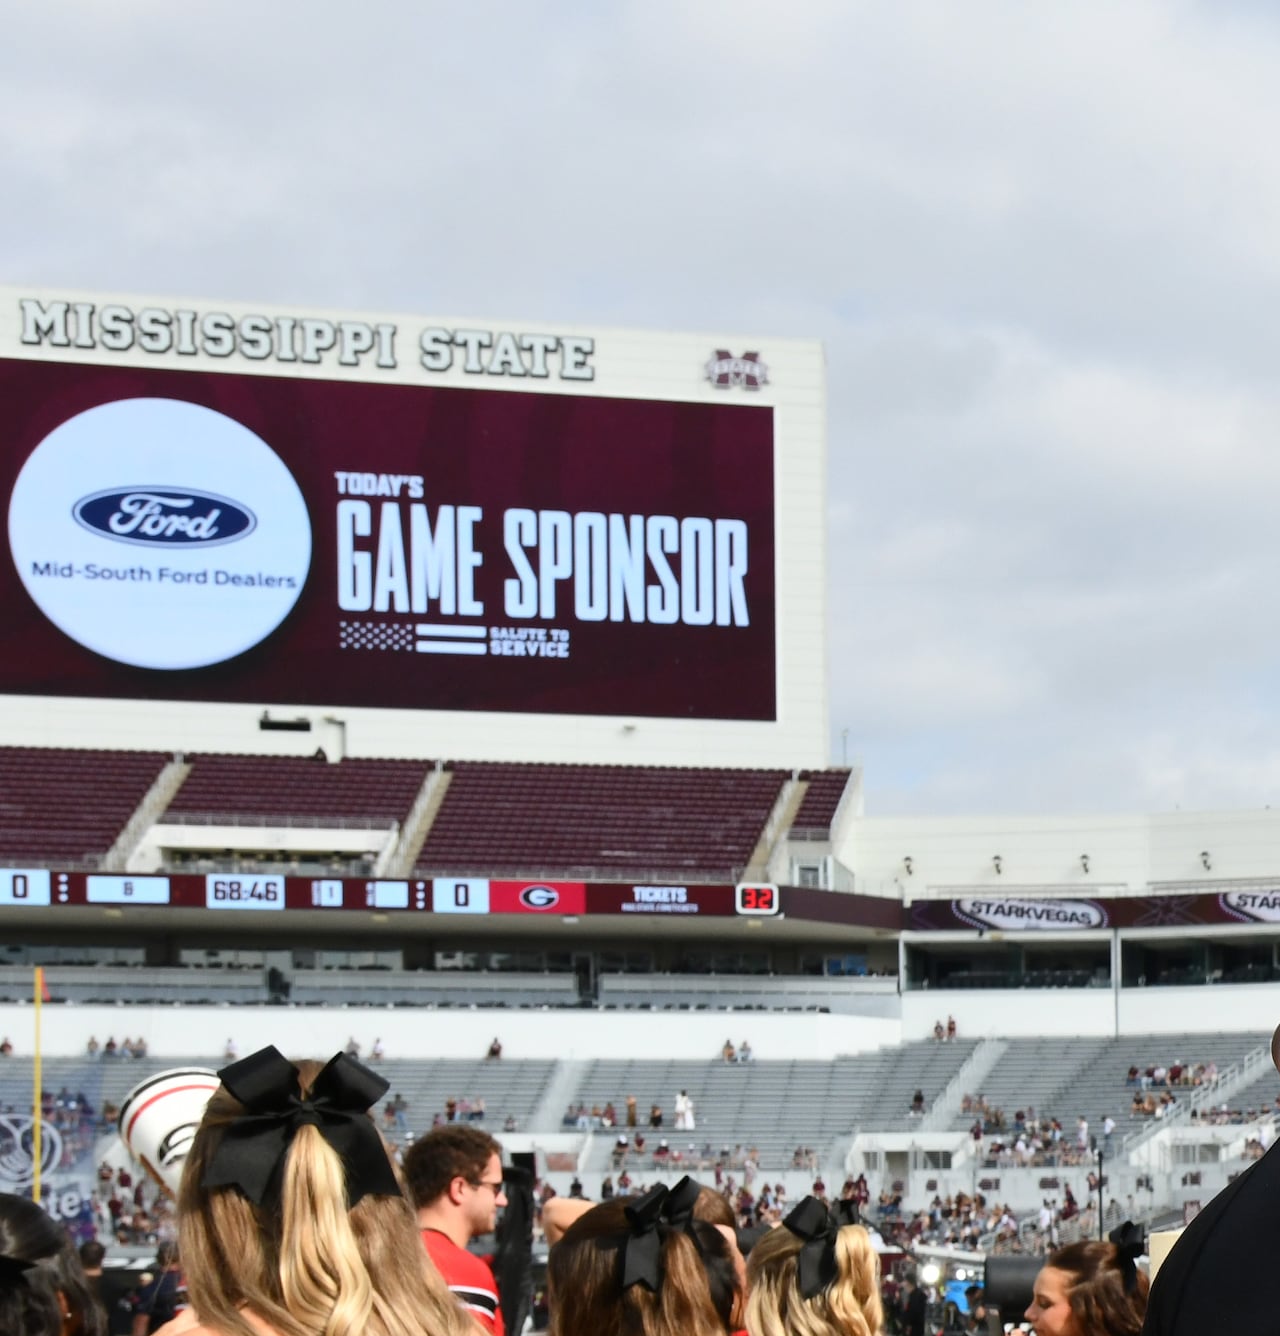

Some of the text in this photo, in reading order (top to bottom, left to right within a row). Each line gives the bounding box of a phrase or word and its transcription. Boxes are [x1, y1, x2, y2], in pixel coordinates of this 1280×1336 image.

[20, 299, 595, 381] MISSISSIPPI STATE
[334, 471, 425, 498] TODAY'S
[109, 493, 221, 540] Ford
[31, 561, 297, 589] Mid-South Ford Dealers
[336, 499, 750, 627] GAME SPONSOR
[490, 626, 570, 642] SALUTE TO
[490, 640, 570, 658] SERVICE
[214, 881, 278, 901] 68:46
[633, 886, 688, 903] TICKETS
[743, 888, 772, 909] 32
[970, 901, 1092, 925] STARKVEGAS
